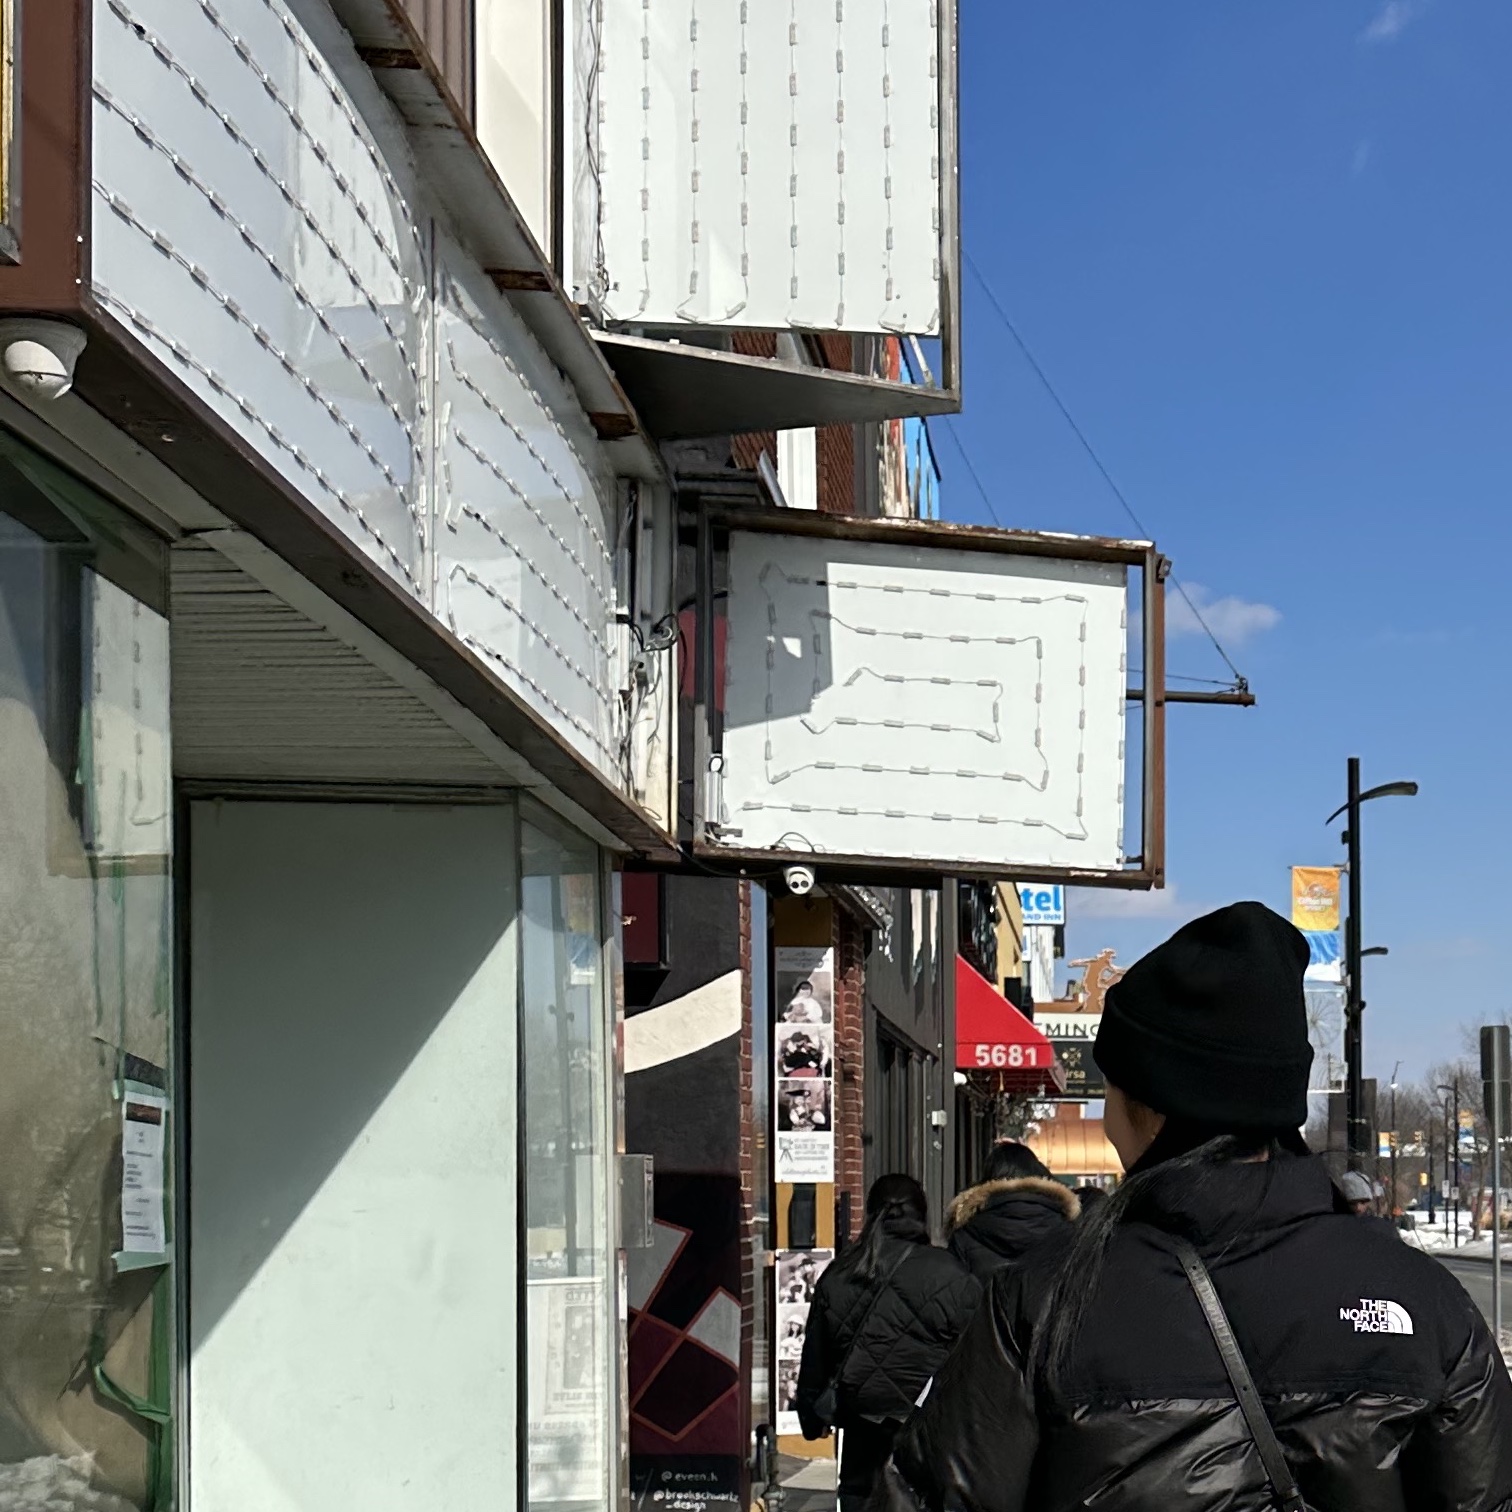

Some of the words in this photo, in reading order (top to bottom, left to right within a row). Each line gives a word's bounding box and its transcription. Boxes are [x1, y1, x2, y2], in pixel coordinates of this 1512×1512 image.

[975, 1044, 1038, 1067] 5681
[1360, 1298, 1387, 1311] THE
[1340, 1307, 1388, 1322] NORTH
[1354, 1320, 1388, 1333] FACE
